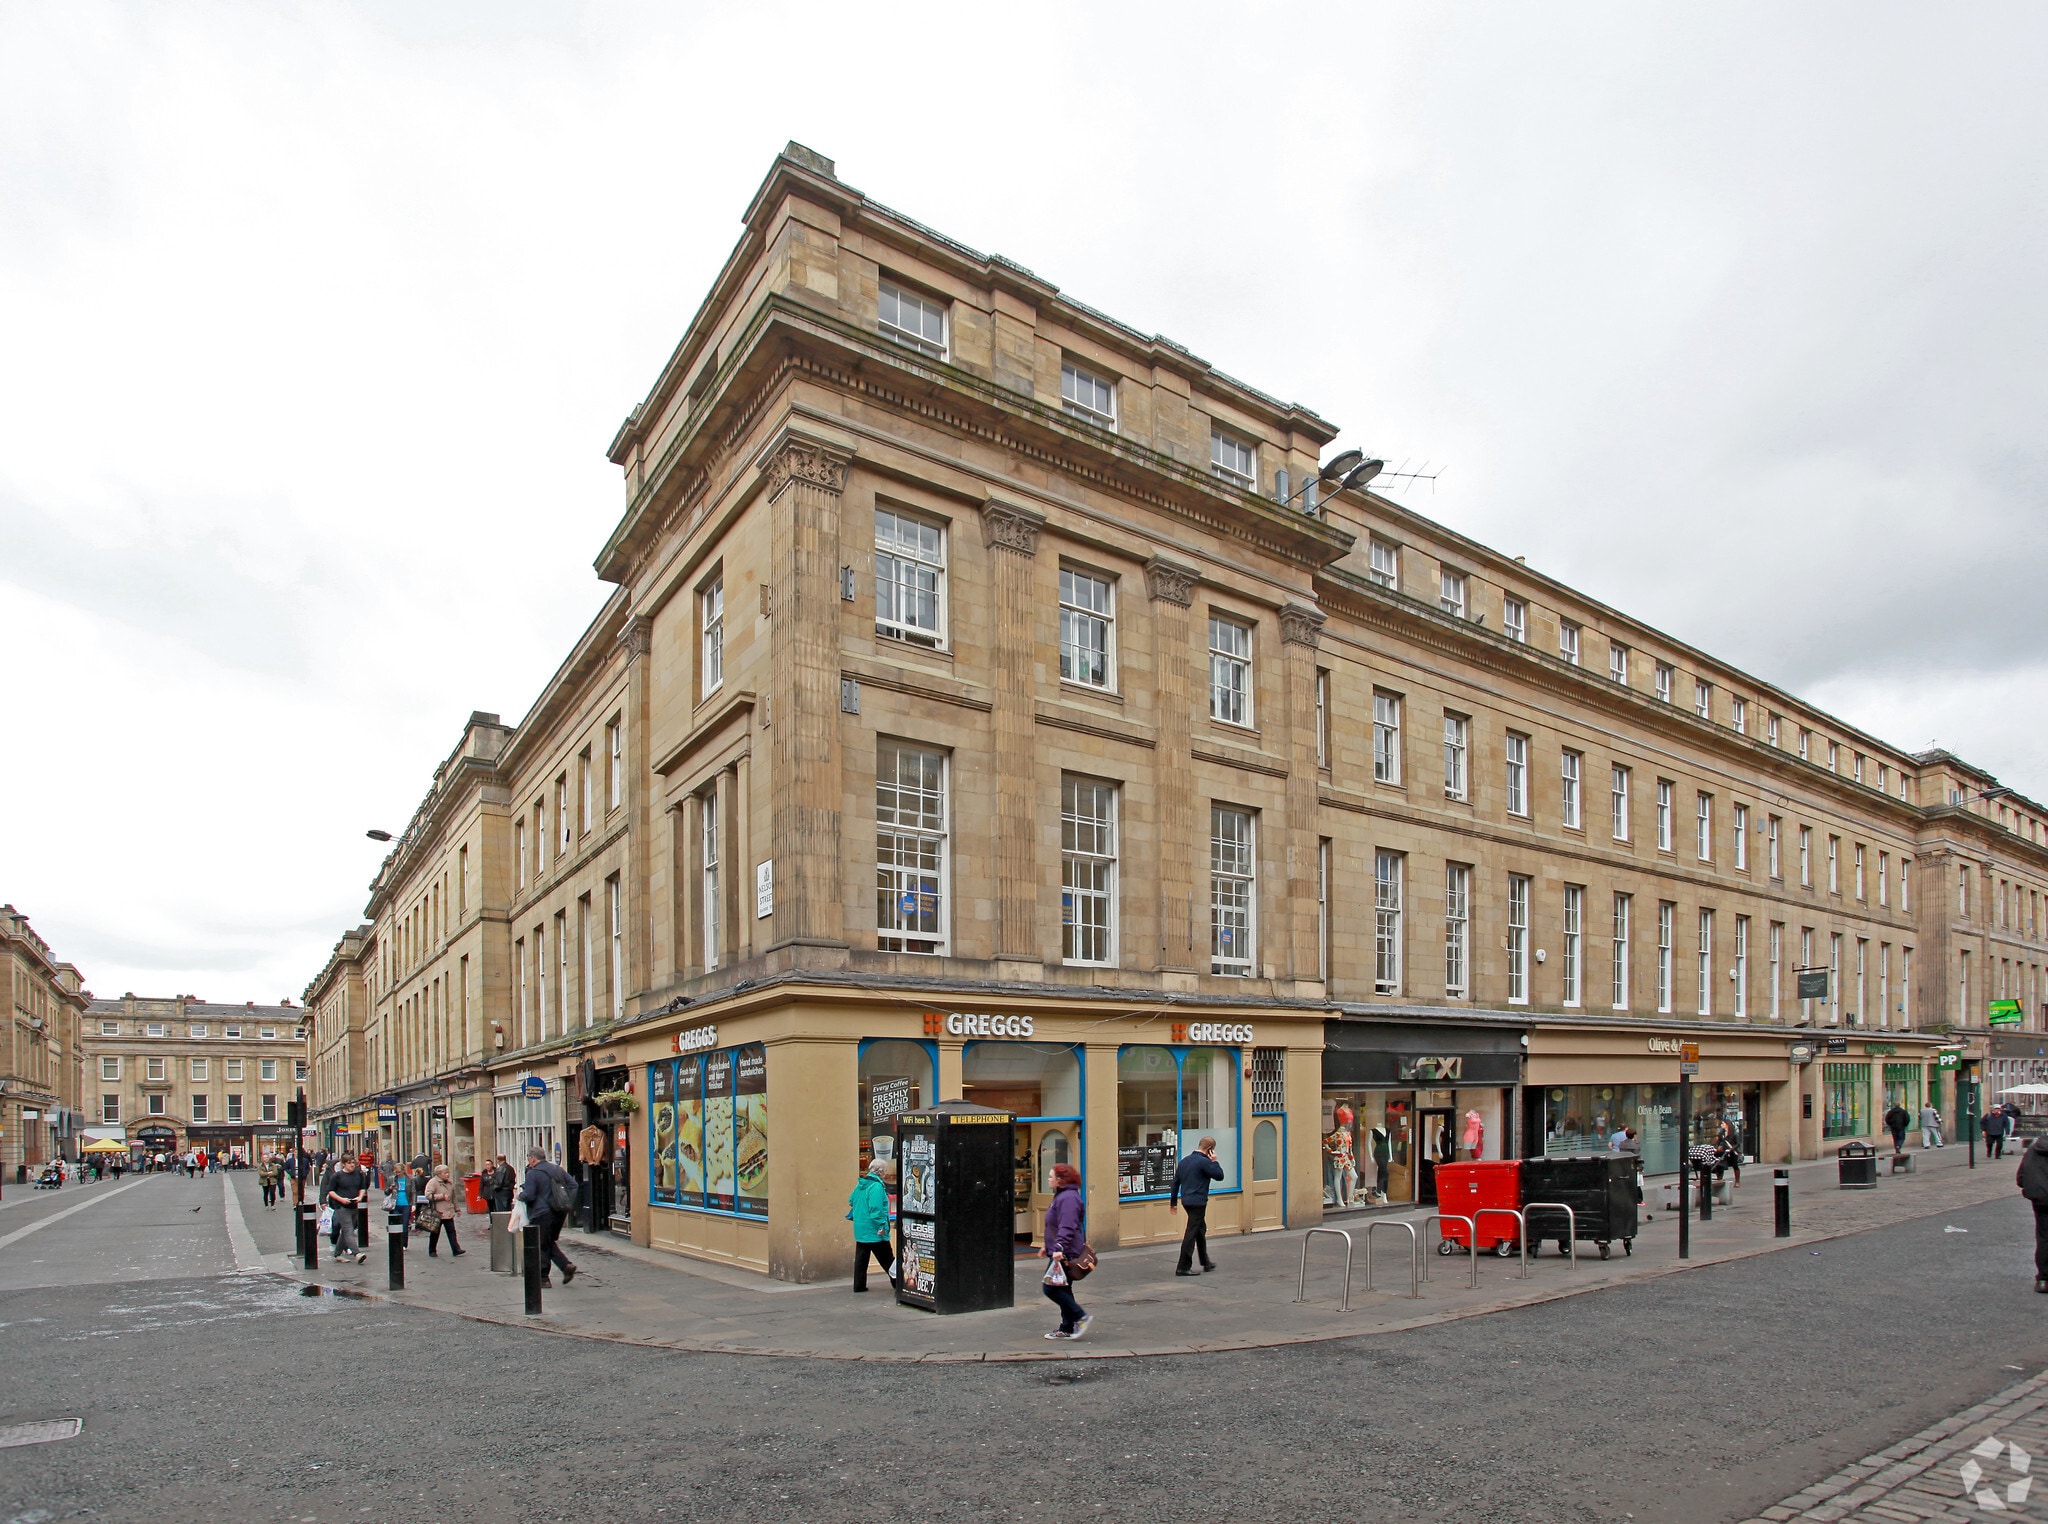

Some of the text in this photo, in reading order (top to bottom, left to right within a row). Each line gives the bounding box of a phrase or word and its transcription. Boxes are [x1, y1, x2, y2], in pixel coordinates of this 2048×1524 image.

[759, 882, 772, 894] NELSO
[947, 1013, 1034, 1038] GREGGS
[1188, 1022, 1254, 1042] GREGGS
[678, 1024, 718, 1051] GREGGS
[1648, 1036, 1670, 1052] Olive
[1670, 1038, 1678, 1052] &
[740, 1057, 763, 1066] Hand made
[1940, 1055, 1958, 1066] PP
[740, 1066, 764, 1077] sandwiches
[1398, 1056, 1462, 1080] LEXI
[873, 1080, 908, 1093] Every Coffee
[873, 1088, 908, 1104] FRESHLY
[873, 1097, 908, 1110] GROUND
[884, 1104, 908, 1114] ORDER
[1638, 1105, 1672, 1115] Olive & Bean
[903, 1116, 913, 1124] WiFi
[918, 1279, 929, 1292] DEC.
[930, 1282, 935, 1294] 7
